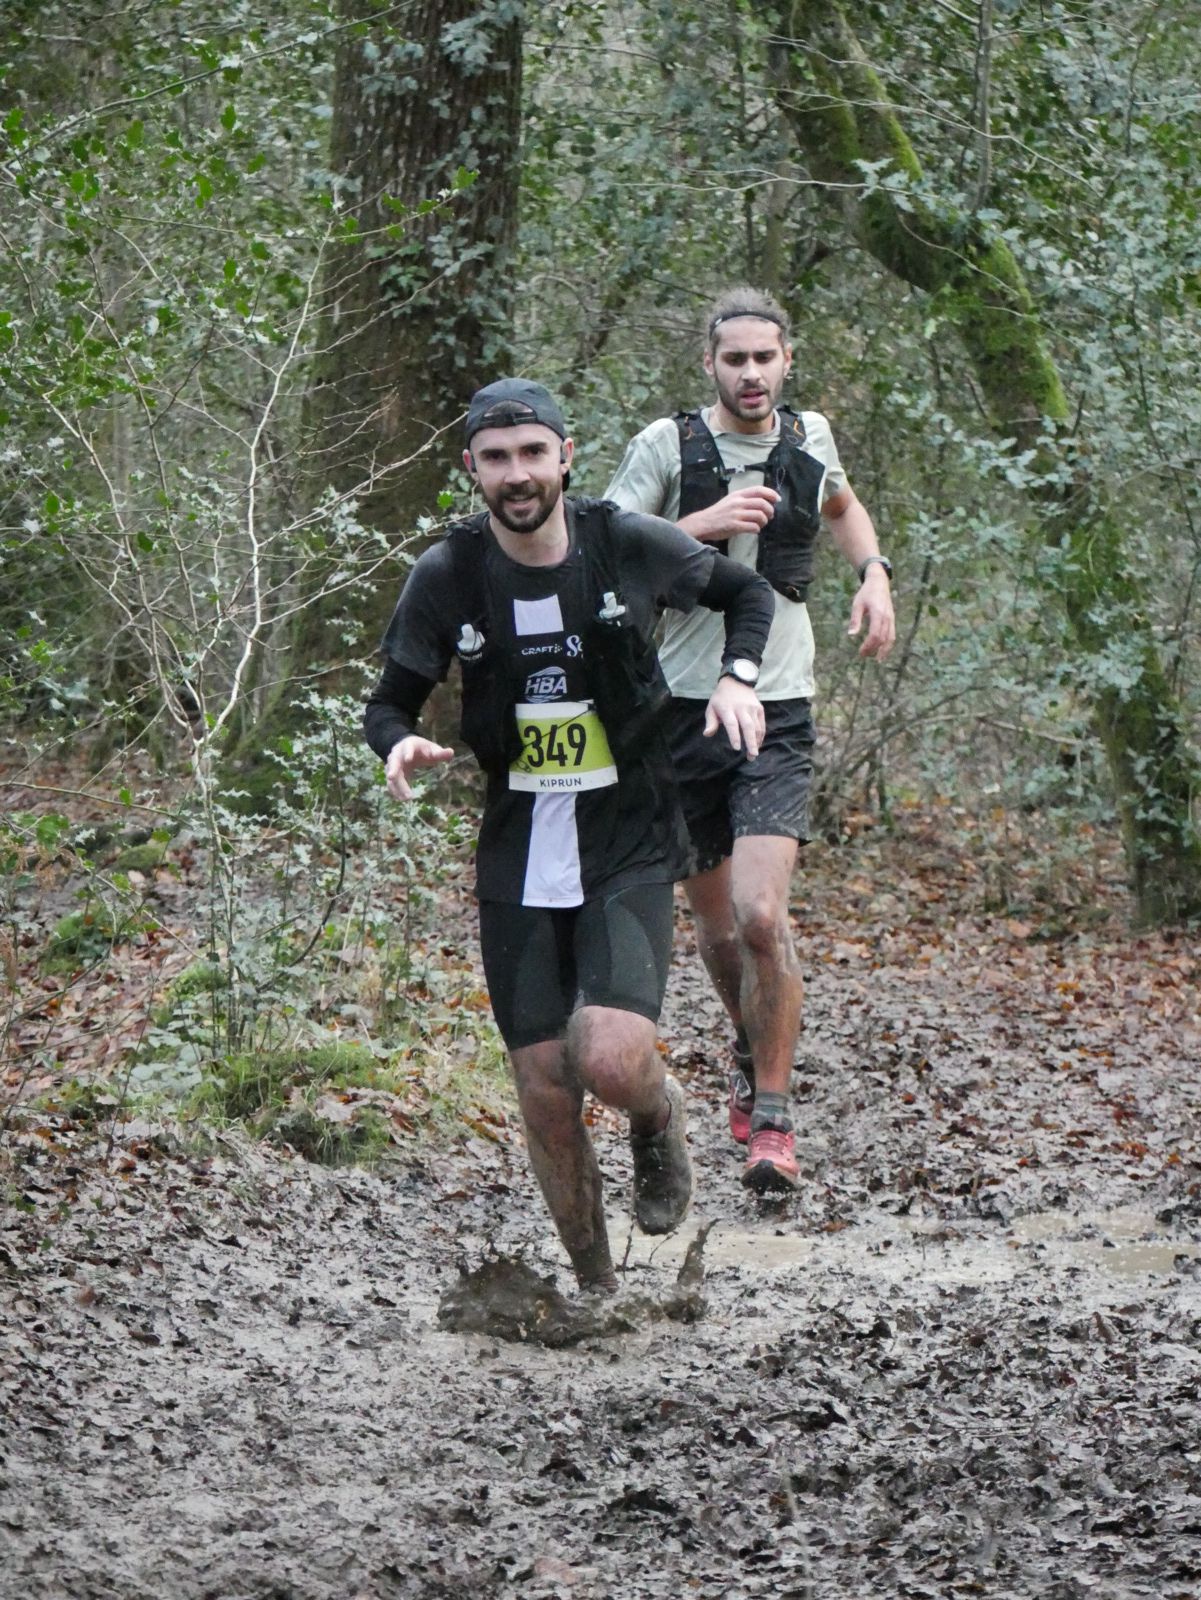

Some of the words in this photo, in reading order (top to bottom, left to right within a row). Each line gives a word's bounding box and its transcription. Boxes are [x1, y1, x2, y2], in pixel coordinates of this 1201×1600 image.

[521, 646, 553, 656] CRAFT
[524, 676, 568, 695] HBA
[523, 723, 587, 768] 349
[540, 777, 582, 788] KIPRUN
